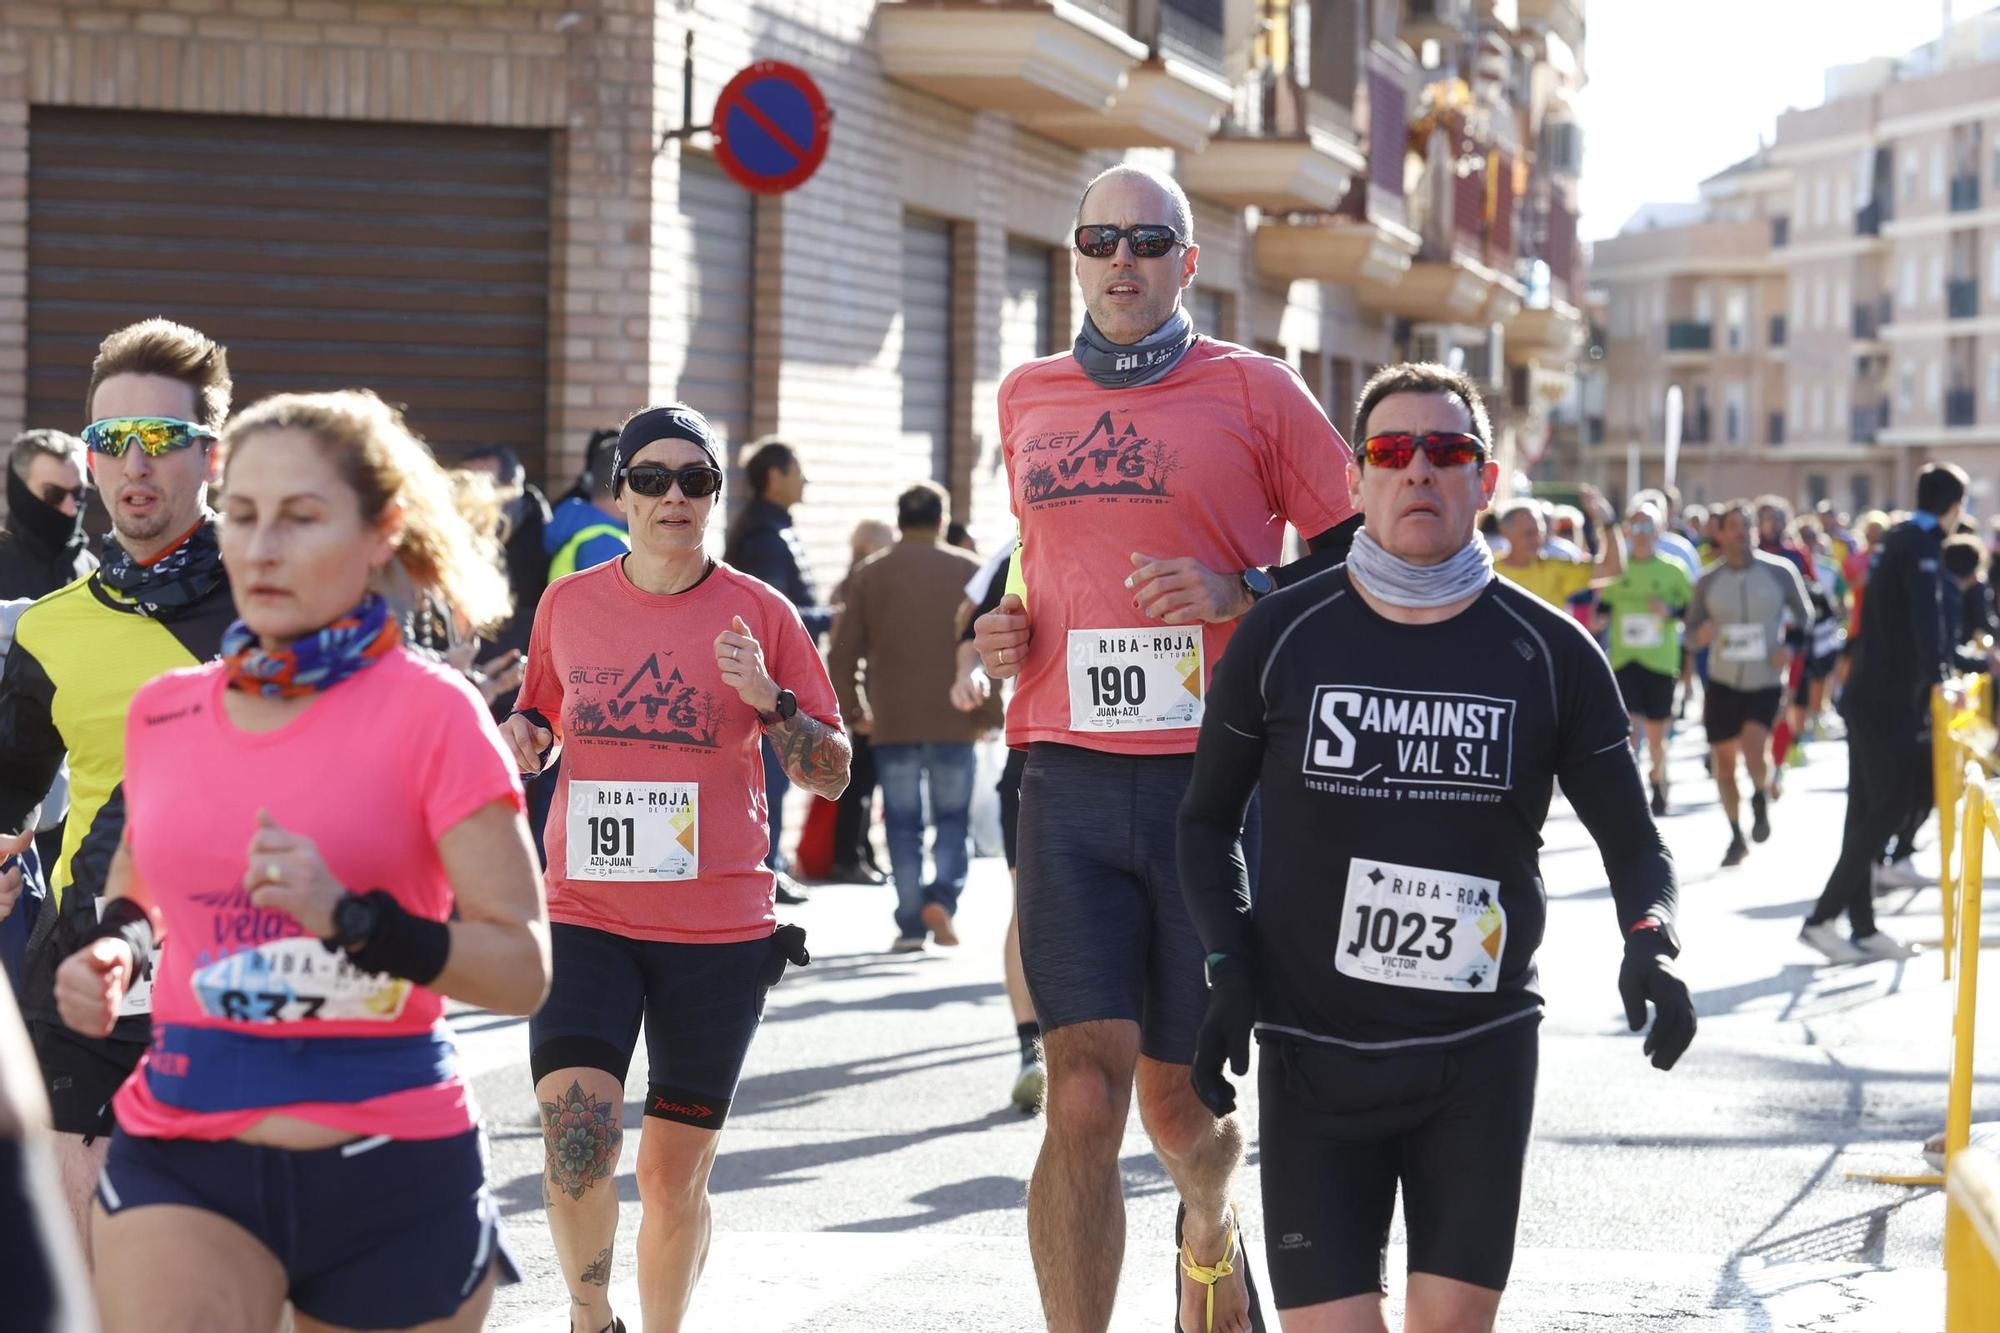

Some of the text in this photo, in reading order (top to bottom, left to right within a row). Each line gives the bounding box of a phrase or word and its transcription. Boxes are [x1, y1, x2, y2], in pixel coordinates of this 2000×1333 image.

[1022, 436, 1078, 453] GILET
[569, 670, 623, 685] GILET
[1087, 665, 1147, 706] 190
[1096, 706, 1140, 717] JUAN+AZU
[1313, 691, 1506, 769] SAMAINST
[1397, 739, 1500, 779] VAL S.L.
[1305, 778, 1503, 803] instalaciones y mantenimiento
[588, 817, 634, 856] 191
[590, 856, 632, 867] AZU+JUAN
[1355, 904, 1457, 962] 1023
[1381, 955, 1419, 970] VICTOR
